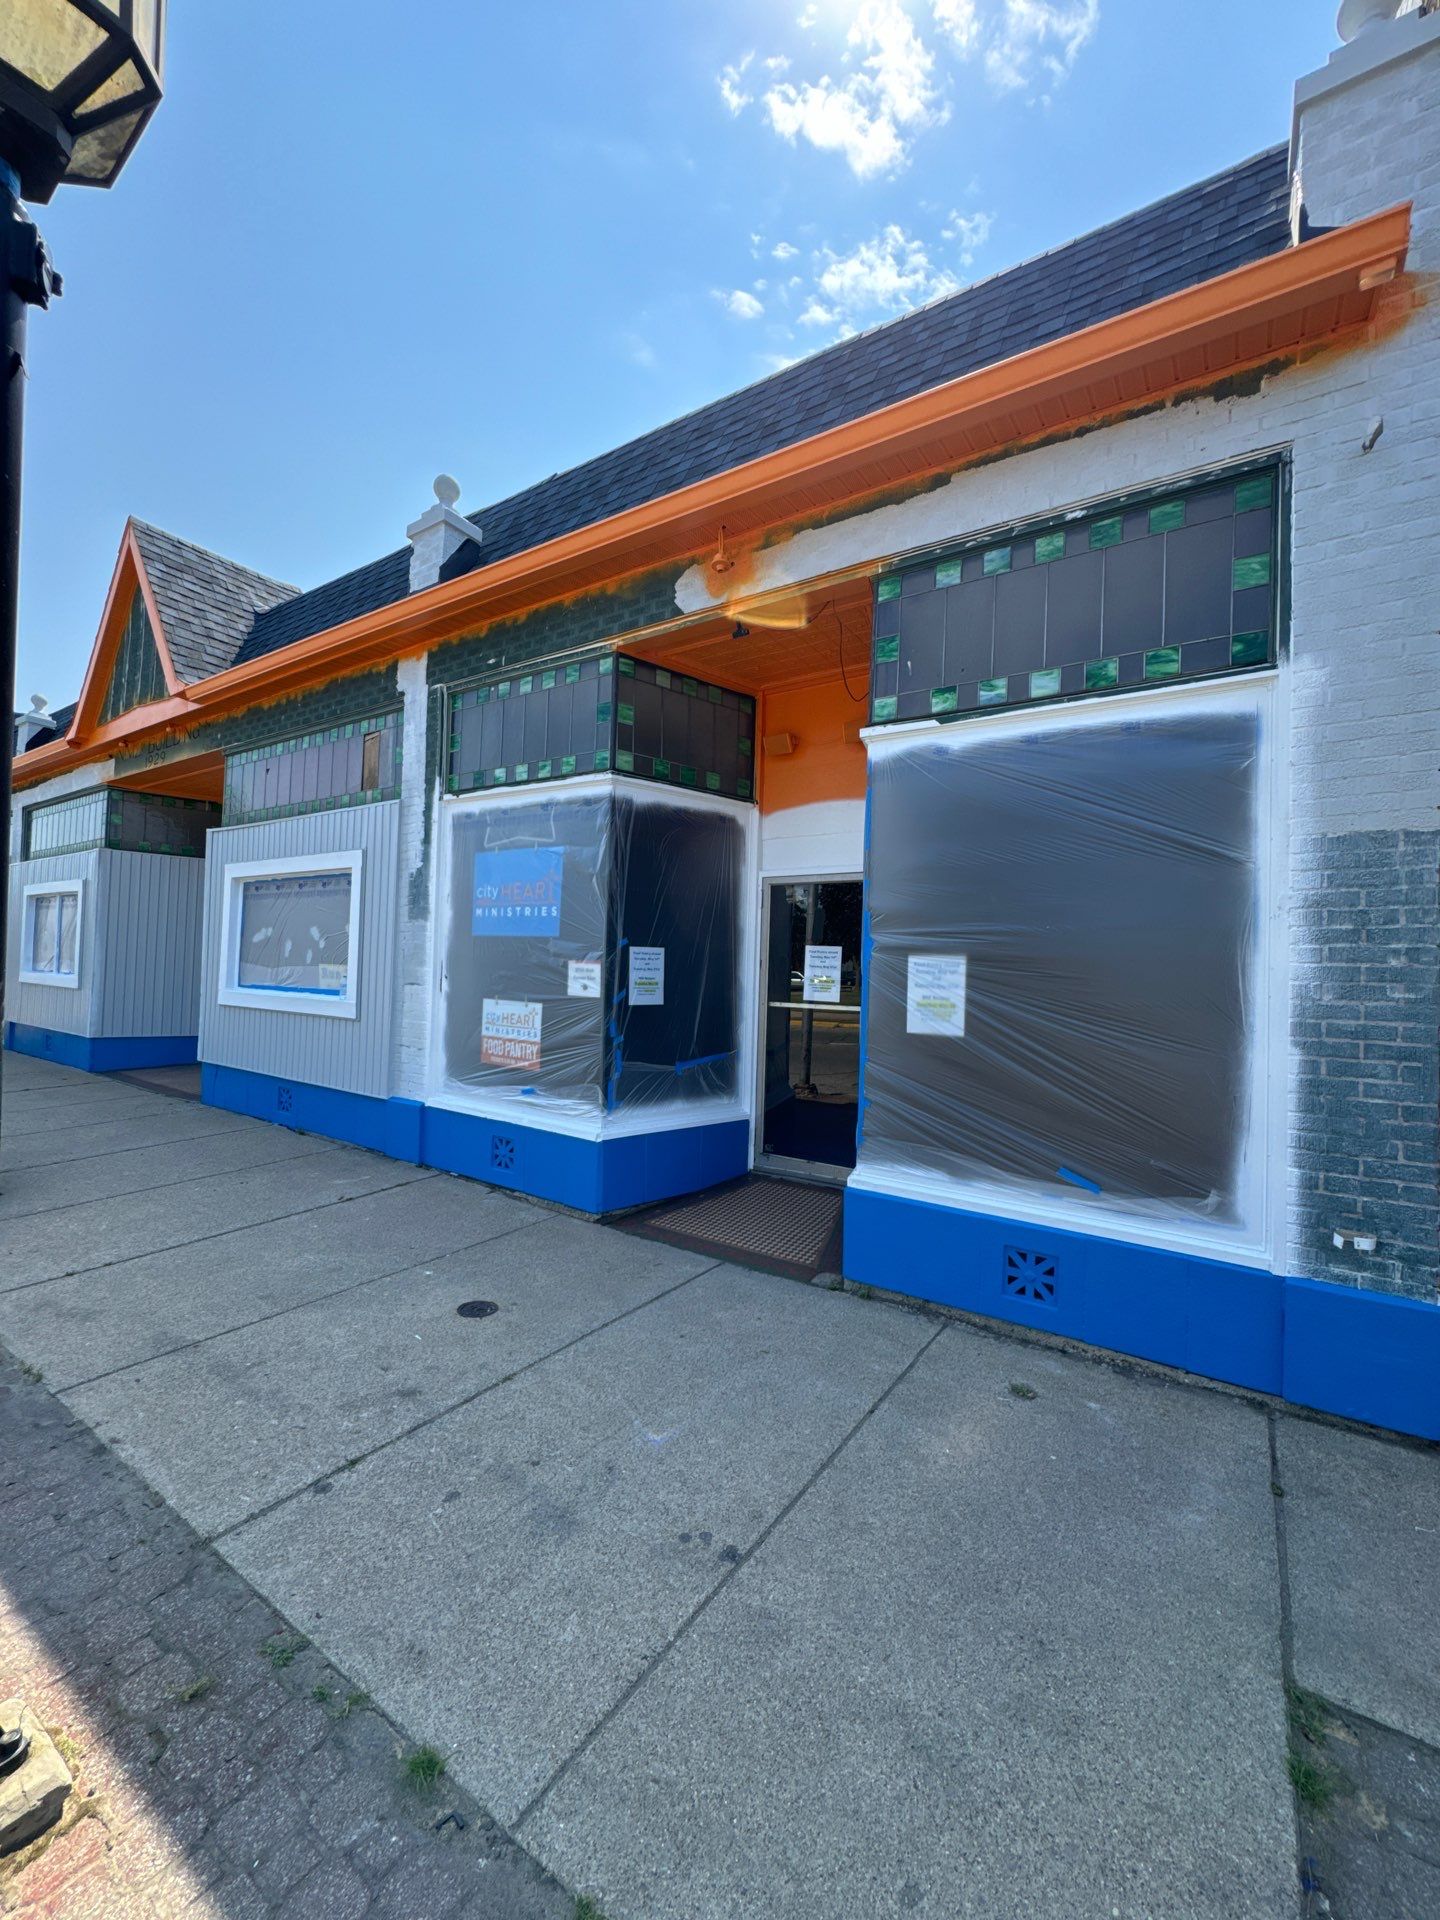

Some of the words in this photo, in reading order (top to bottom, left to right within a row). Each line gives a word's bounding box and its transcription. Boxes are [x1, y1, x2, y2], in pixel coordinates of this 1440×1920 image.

[145, 751, 166, 768] 1929
[476, 883, 499, 900] city
[501, 877, 557, 903] HEART
[475, 906, 558, 917] MINISTRIES
[502, 1012, 536, 1028] HEART
[485, 1026, 538, 1039] MINISTRIES
[483, 1038, 504, 1056] FOOD
[505, 1041, 538, 1060] PANTRY
